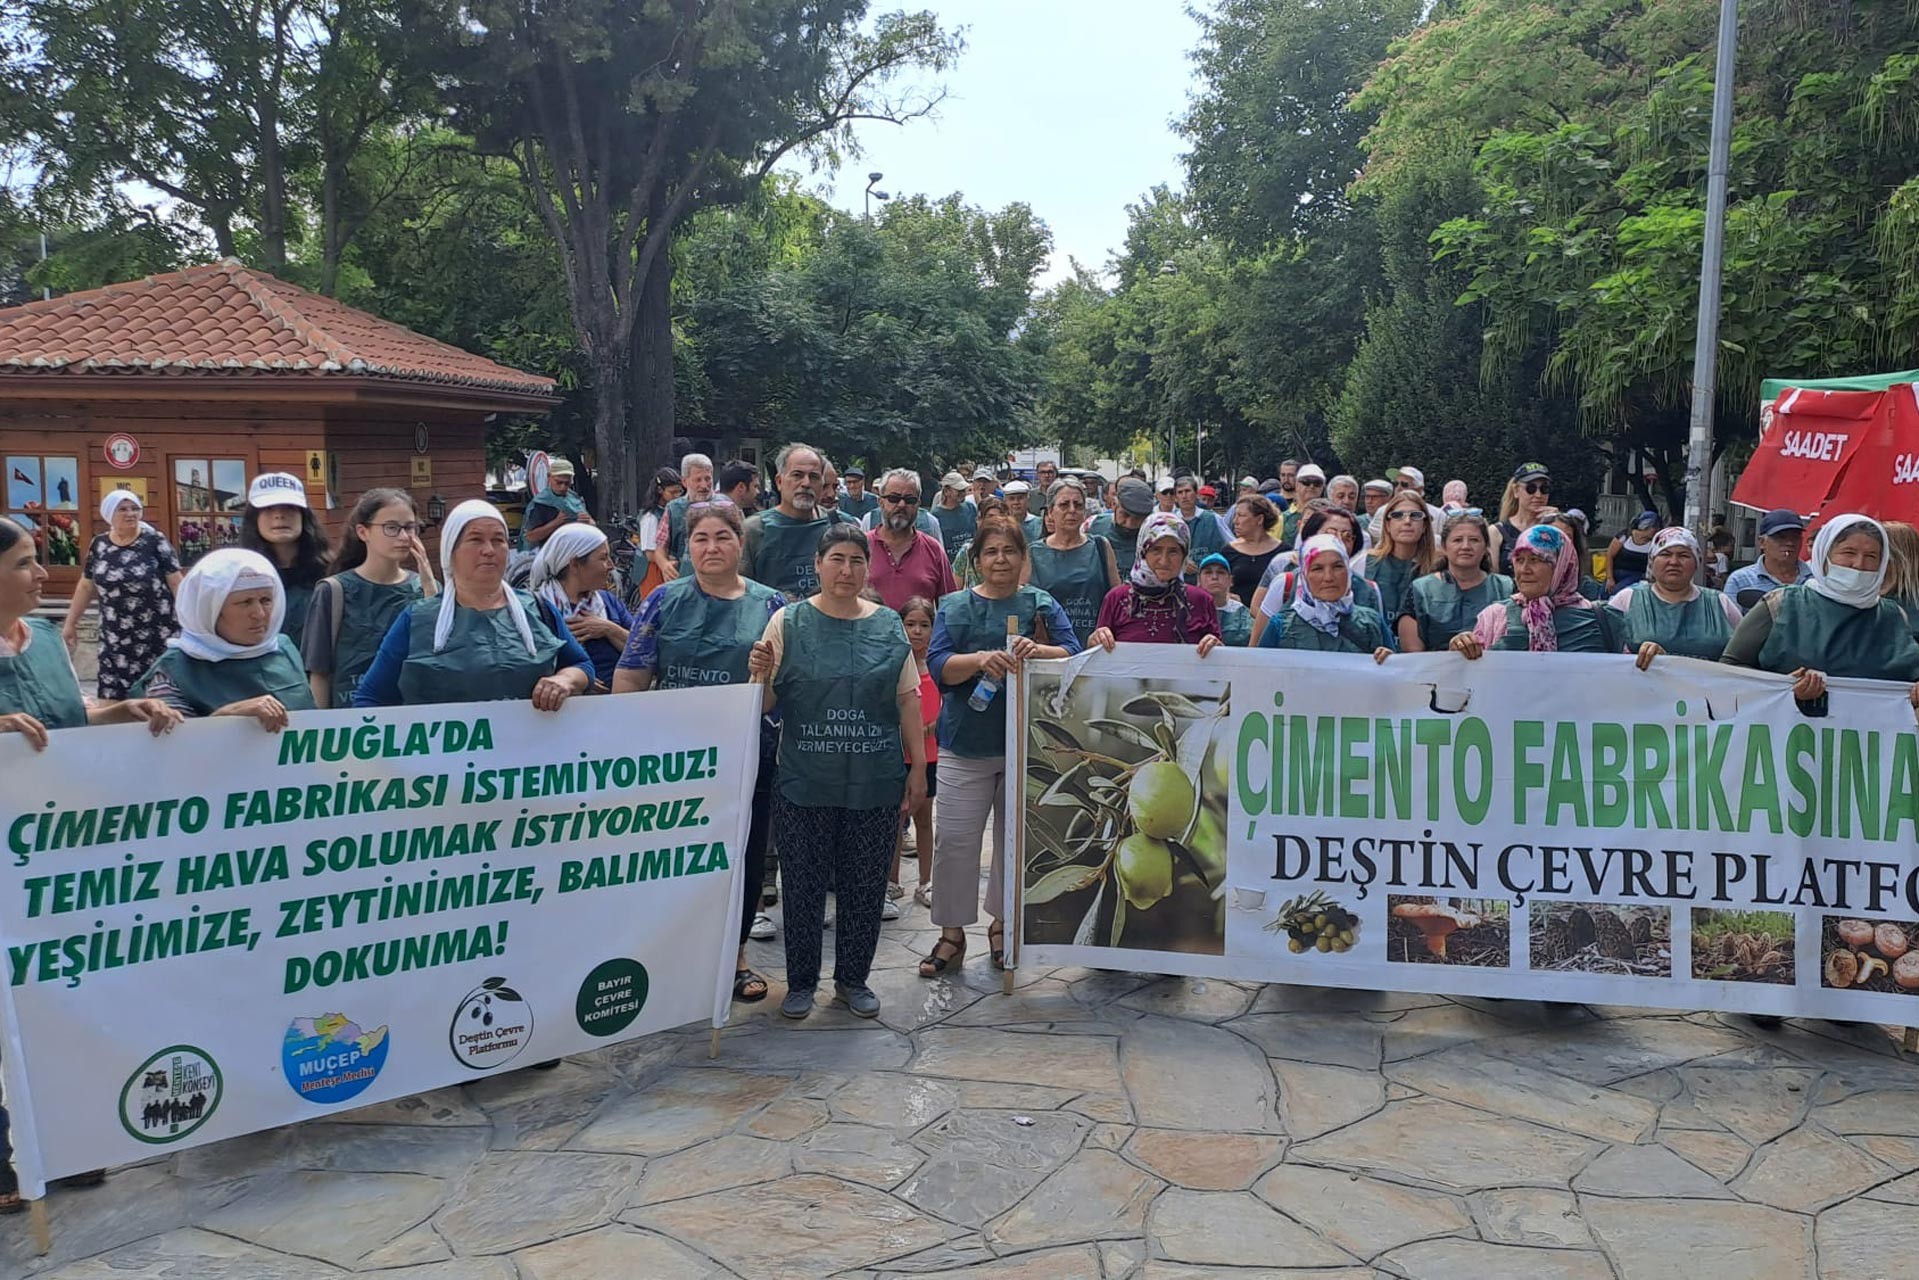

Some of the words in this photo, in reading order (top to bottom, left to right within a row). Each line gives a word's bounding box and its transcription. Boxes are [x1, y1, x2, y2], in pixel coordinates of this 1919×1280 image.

[1780, 430, 1848, 462] SAADET
[278, 715, 494, 765] MUĞLA'DA
[800, 724, 866, 737] TALANINA
[1235, 691, 1494, 841] ÇİMENTO
[1513, 700, 1919, 843] FABRİKASINA
[8, 795, 210, 867] ÇİMENTO
[224, 770, 449, 829] FABRİKASI
[461, 746, 718, 805] İSTEMİYORUZ!
[24, 853, 164, 919] TEMİZ
[176, 845, 289, 895] HAVA
[303, 820, 502, 876] SOLUMAK
[511, 797, 710, 849] İSTİYORUZ.
[1271, 829, 1483, 900] DEŞTİN
[1497, 843, 1698, 908] ÇEVRE
[8, 904, 261, 988] YEŞİLİMİZE,
[275, 862, 544, 939] ZEYTİNİMİZE,
[558, 841, 729, 894] BALIMIZA
[283, 920, 509, 994] DOKUNMA!
[594, 988, 632, 1008] ÇEVRE
[598, 975, 632, 991] BAYIR
[459, 1030, 493, 1045] Deştin
[495, 1024, 525, 1038] Çevre
[469, 1039, 518, 1055] Platformu
[300, 1051, 360, 1076] MUÇEP
